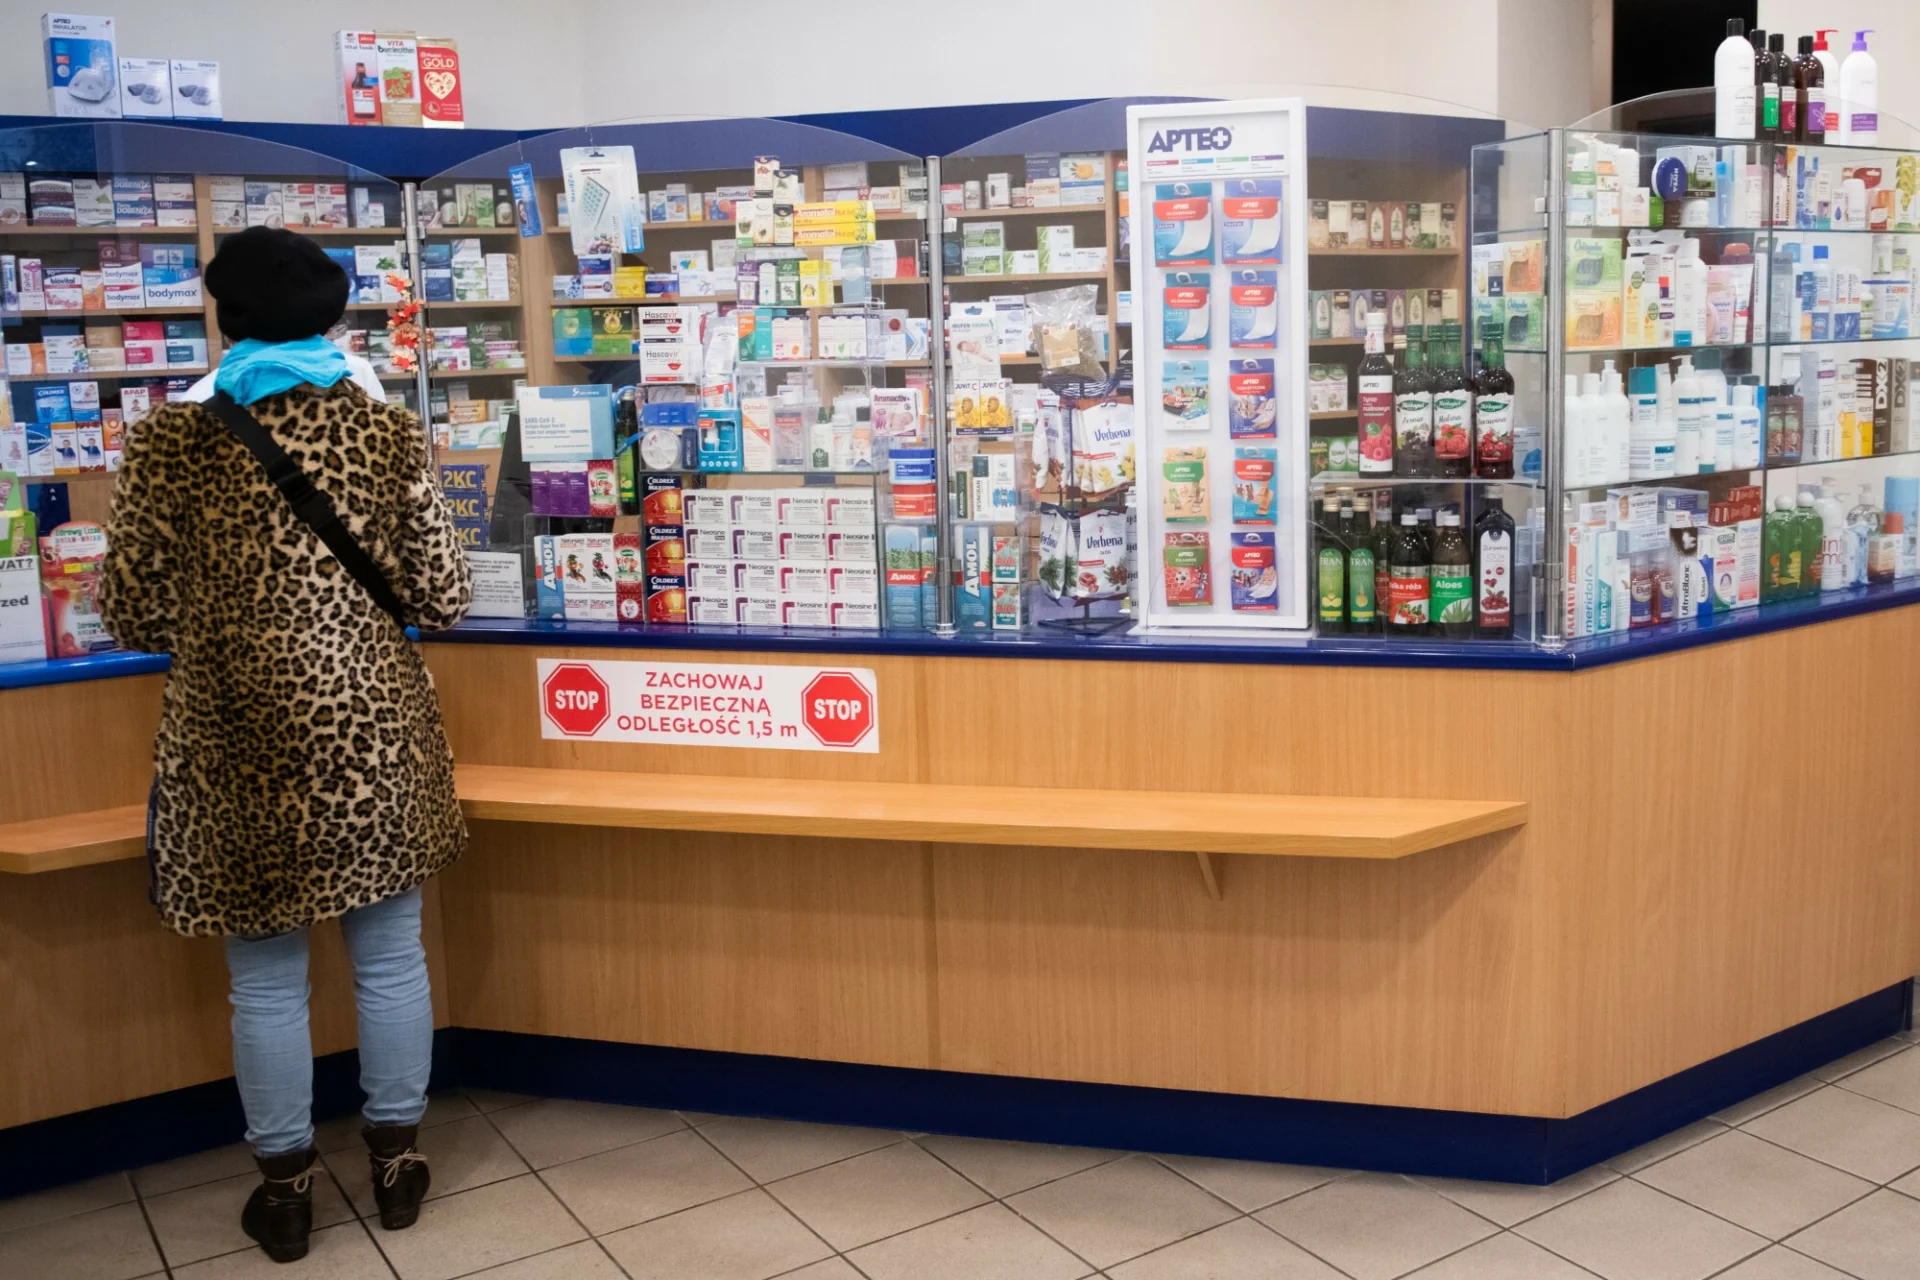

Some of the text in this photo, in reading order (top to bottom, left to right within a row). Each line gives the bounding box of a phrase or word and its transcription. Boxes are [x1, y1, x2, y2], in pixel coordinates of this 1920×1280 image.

[422, 58, 455, 68] GOLD
[104, 270, 138, 279] bodymax
[106, 293, 141, 302] bodymax
[148, 288, 197, 298] bodymax
[644, 311, 679, 319] Hascovir
[646, 350, 679, 358] Hascovir
[1875, 360, 1888, 409] DX2
[1894, 359, 1905, 408] DX2
[1094, 428, 1131, 441] Verbena
[443, 471, 477, 488] 2KC
[647, 477, 675, 485] COLDREX
[56, 528, 82, 536] Zdrowy
[649, 526, 677, 536] COLDREX
[1086, 535, 1123, 548] Verbena
[543, 541, 557, 591] AMOL
[1320, 558, 1343, 566] TRAN
[1351, 558, 1374, 566] TRAN
[965, 541, 980, 599] AMOL
[651, 576, 679, 585] COLDREX
[890, 573, 916, 581] AMOL
[1435, 580, 1463, 589] Aloes
[1585, 578, 1593, 633] meridol
[1600, 588, 1608, 627] elmex
[646, 672, 764, 691] ZACHOWAJ
[555, 689, 599, 711] STOP
[641, 694, 772, 718] BEZPIECZNĄ
[814, 699, 862, 721] STOP
[617, 714, 798, 738] ODLEGŁOŚĆ 1,5 m
